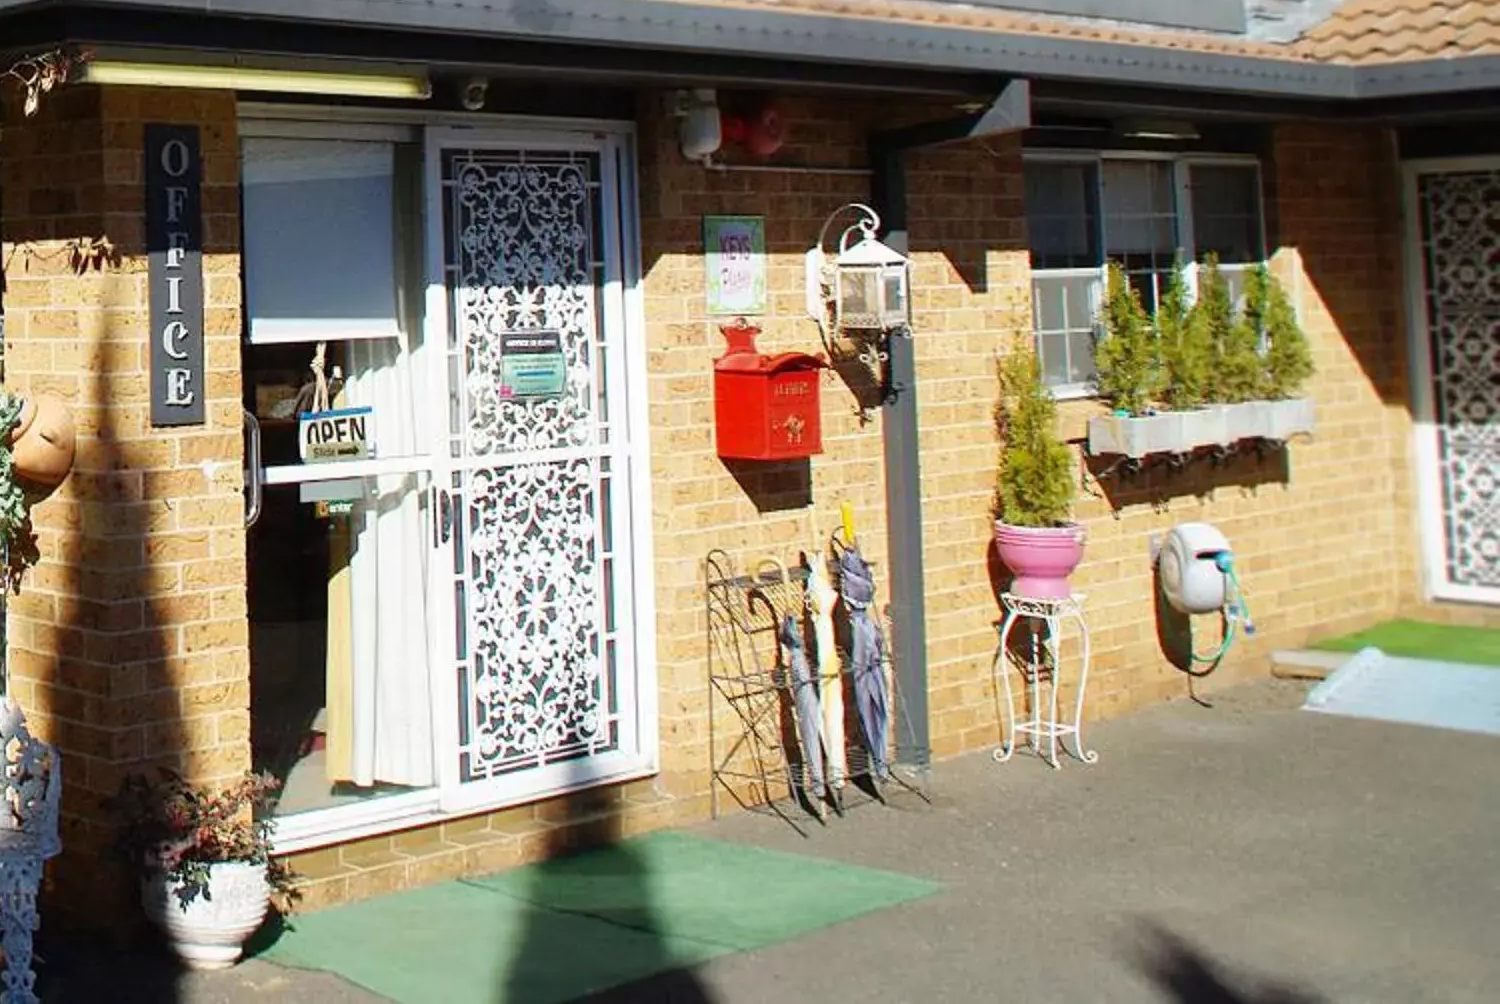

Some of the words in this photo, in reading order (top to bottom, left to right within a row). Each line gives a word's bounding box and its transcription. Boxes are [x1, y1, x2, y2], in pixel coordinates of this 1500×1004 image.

[720, 234, 751, 261] KEYS
[161, 139, 194, 407] OFFICE
[307, 416, 366, 444] OPEN
